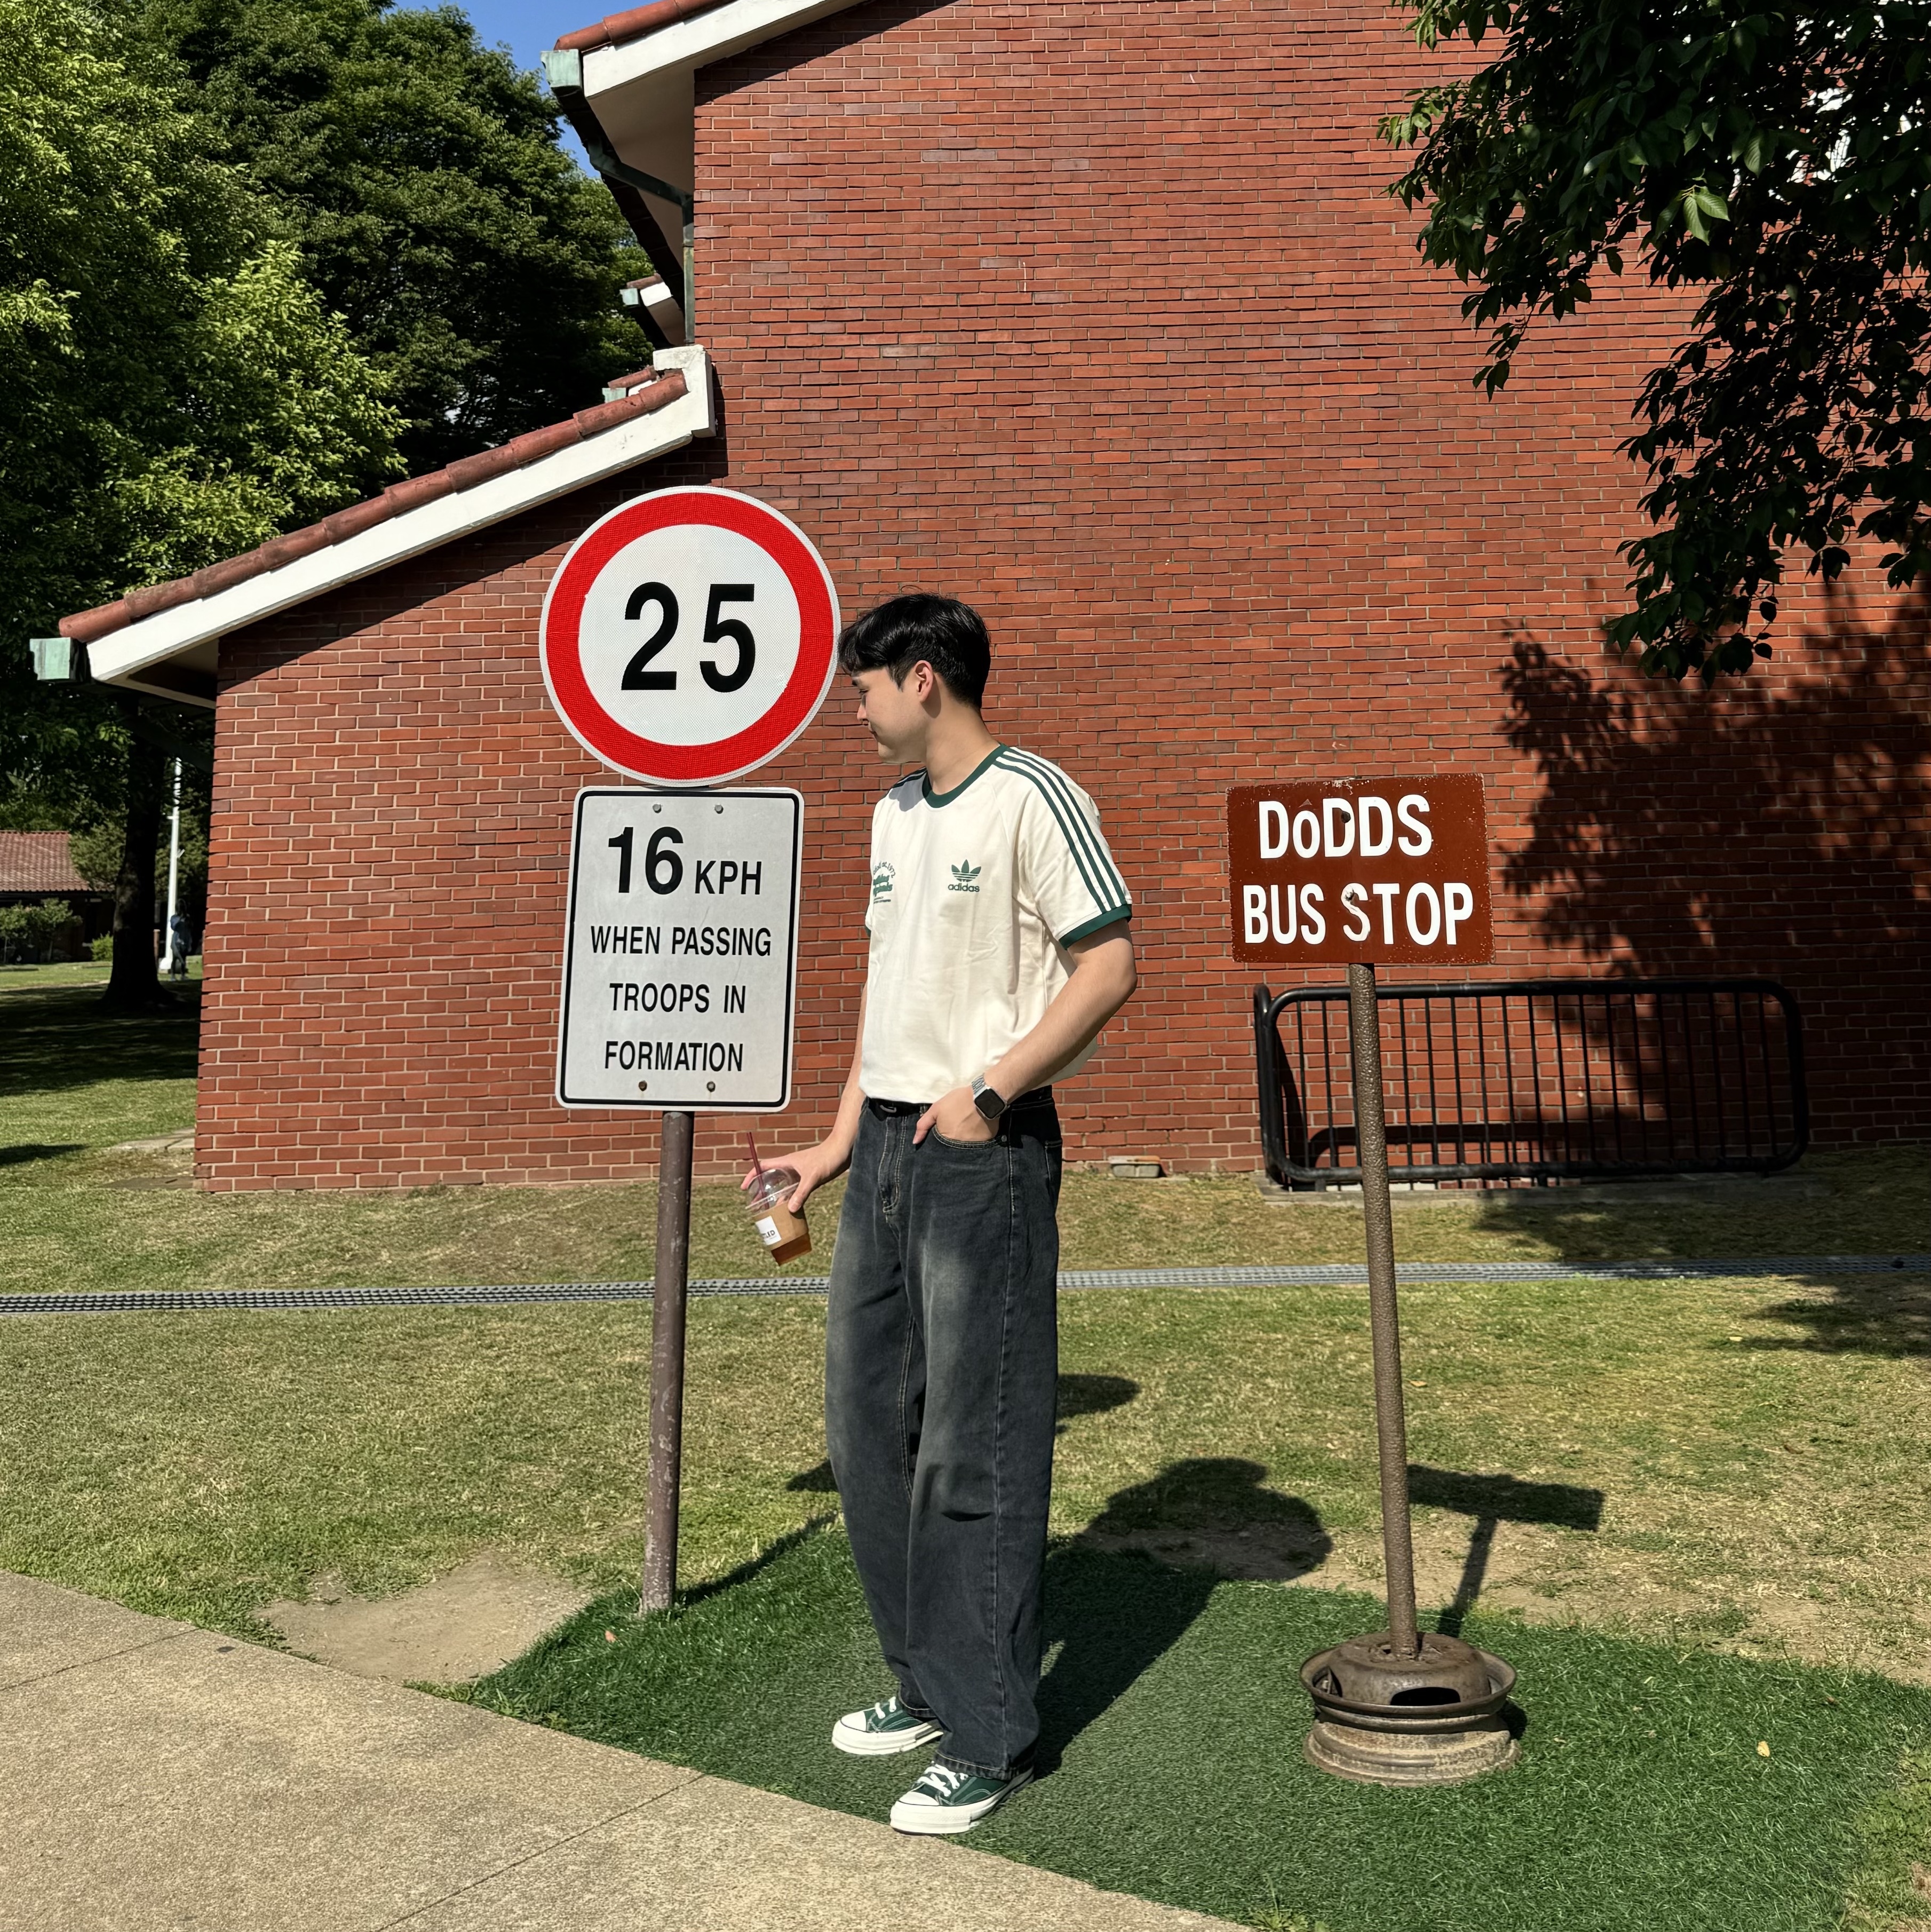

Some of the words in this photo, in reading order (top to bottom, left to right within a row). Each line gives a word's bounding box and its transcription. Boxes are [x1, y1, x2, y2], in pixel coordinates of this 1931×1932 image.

[621, 582, 756, 693] 25
[1259, 795, 1434, 859] DoDDS
[608, 827, 683, 894] 16
[695, 860, 761, 894] KPH
[948, 883, 980, 892] adidas
[1243, 883, 1326, 945] BUS
[1340, 882, 1473, 946] STOP
[591, 926, 661, 954] WHEN
[672, 927, 771, 956] PASSING
[609, 983, 710, 1013] TROOPS
[724, 985, 746, 1013] IN
[605, 1041, 743, 1072] FORMATION
